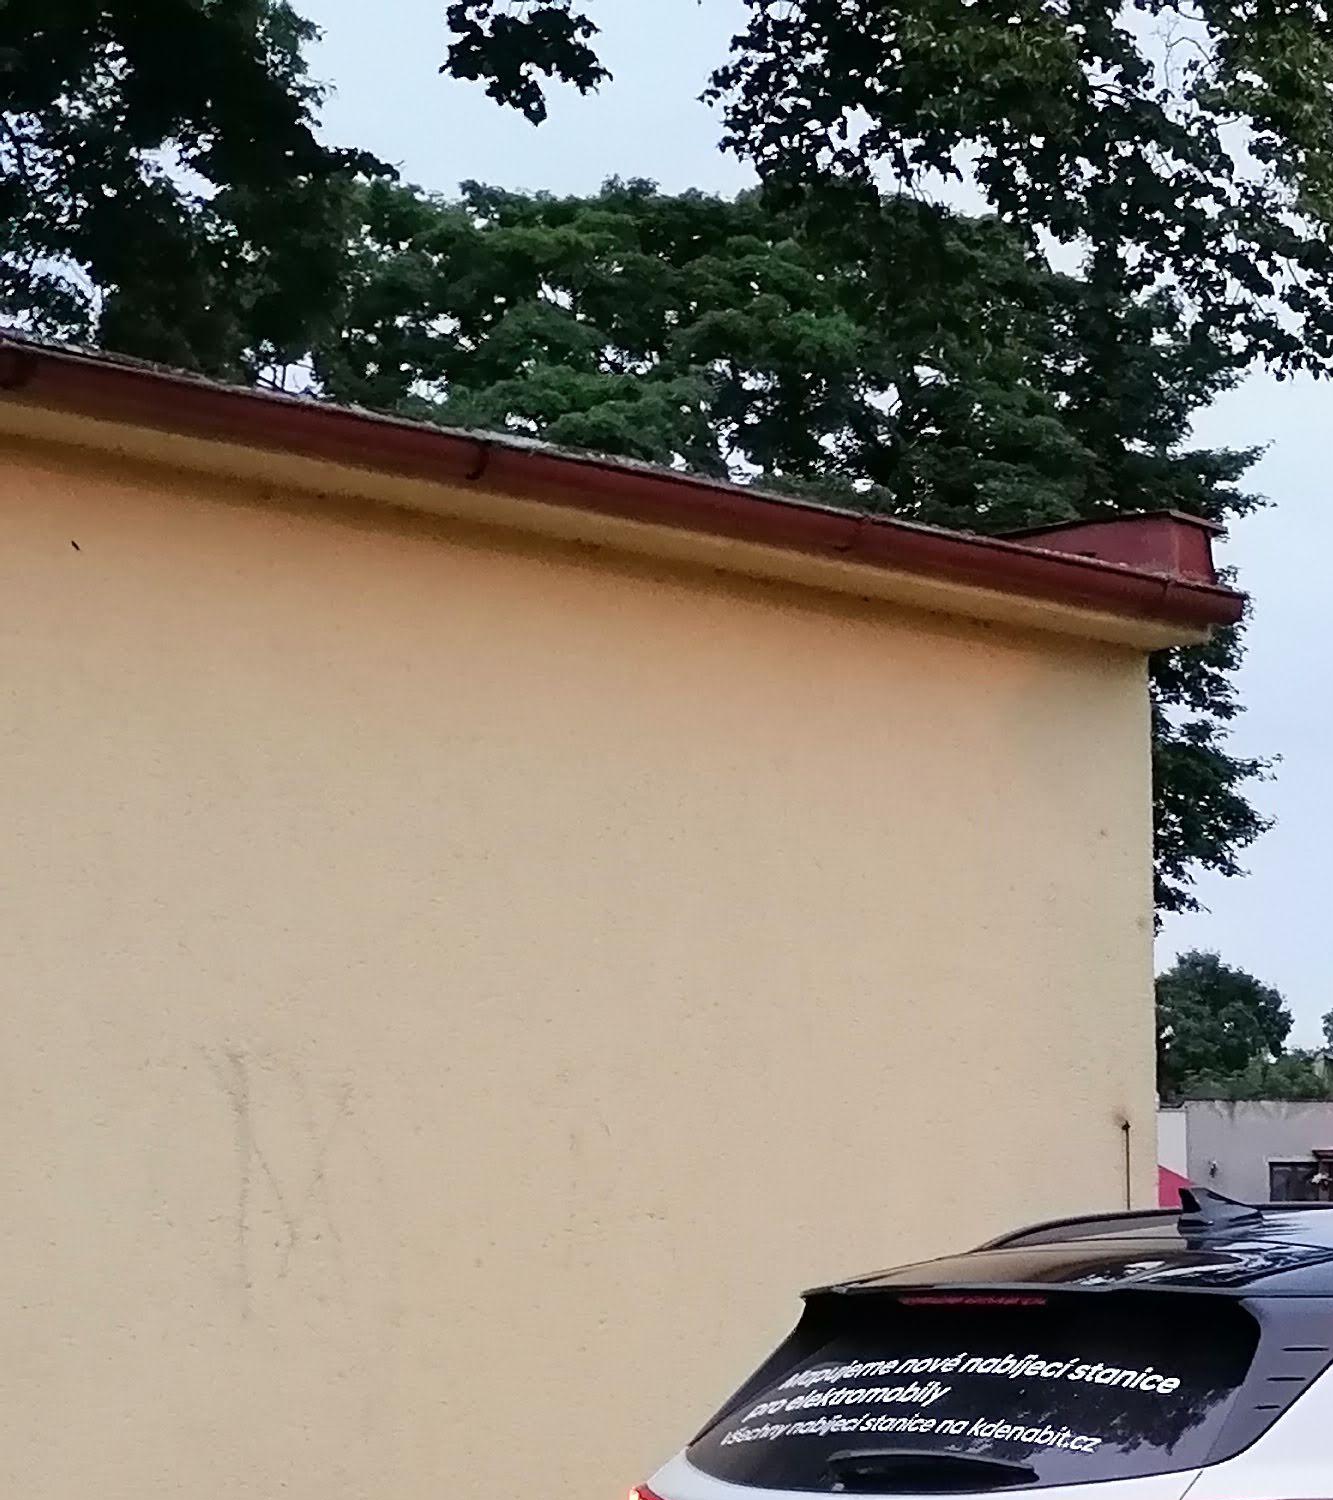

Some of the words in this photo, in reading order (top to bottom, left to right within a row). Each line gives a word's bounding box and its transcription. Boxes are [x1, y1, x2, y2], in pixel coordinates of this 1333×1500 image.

[894, 1352, 967, 1374] nové
[958, 1353, 1080, 1379] nabíjecí
[1068, 1363, 1180, 1394] stanice
[741, 1399, 788, 1423] pro
[785, 1380, 951, 1407] elektromobily
[858, 1411, 934, 1432] stanice
[934, 1418, 969, 1435] na
[966, 1417, 1102, 1453] kdenabit.cz
